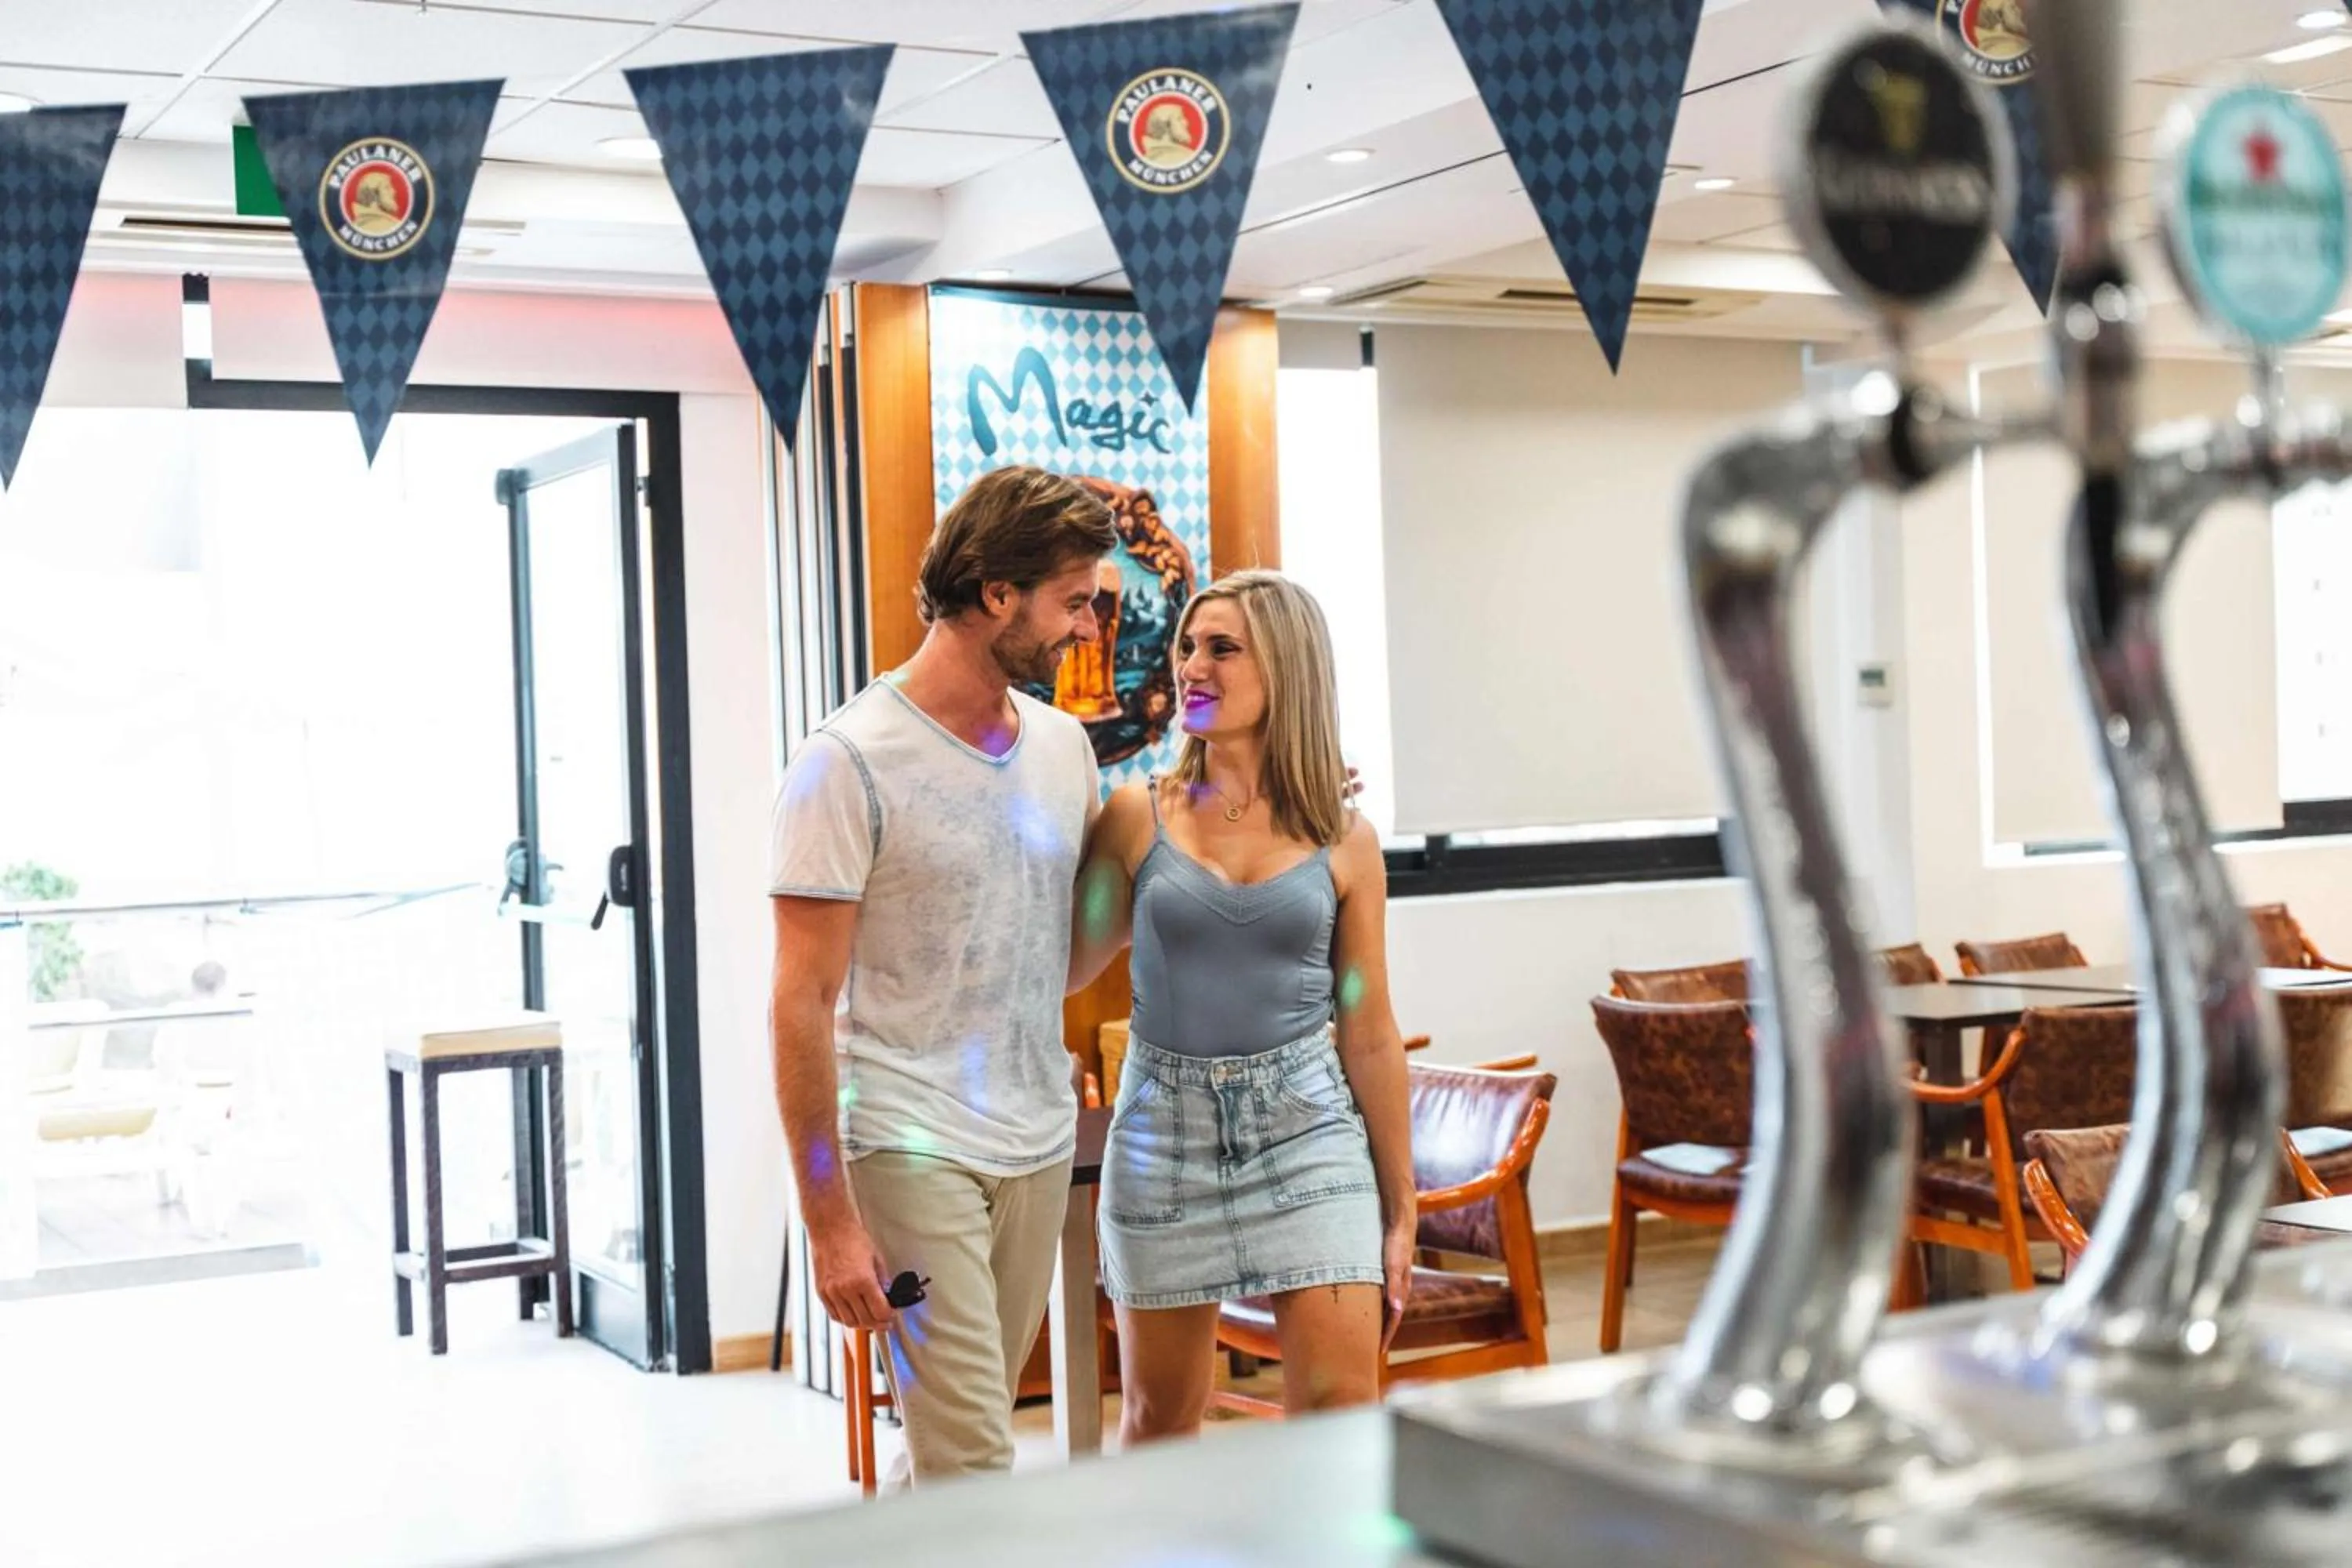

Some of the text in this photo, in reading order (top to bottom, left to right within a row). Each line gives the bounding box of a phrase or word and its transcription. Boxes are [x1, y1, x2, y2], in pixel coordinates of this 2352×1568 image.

[1116, 74, 1218, 124] PAULANER
[328, 144, 423, 189] PAULANER
[967, 346, 1171, 457] Magic
